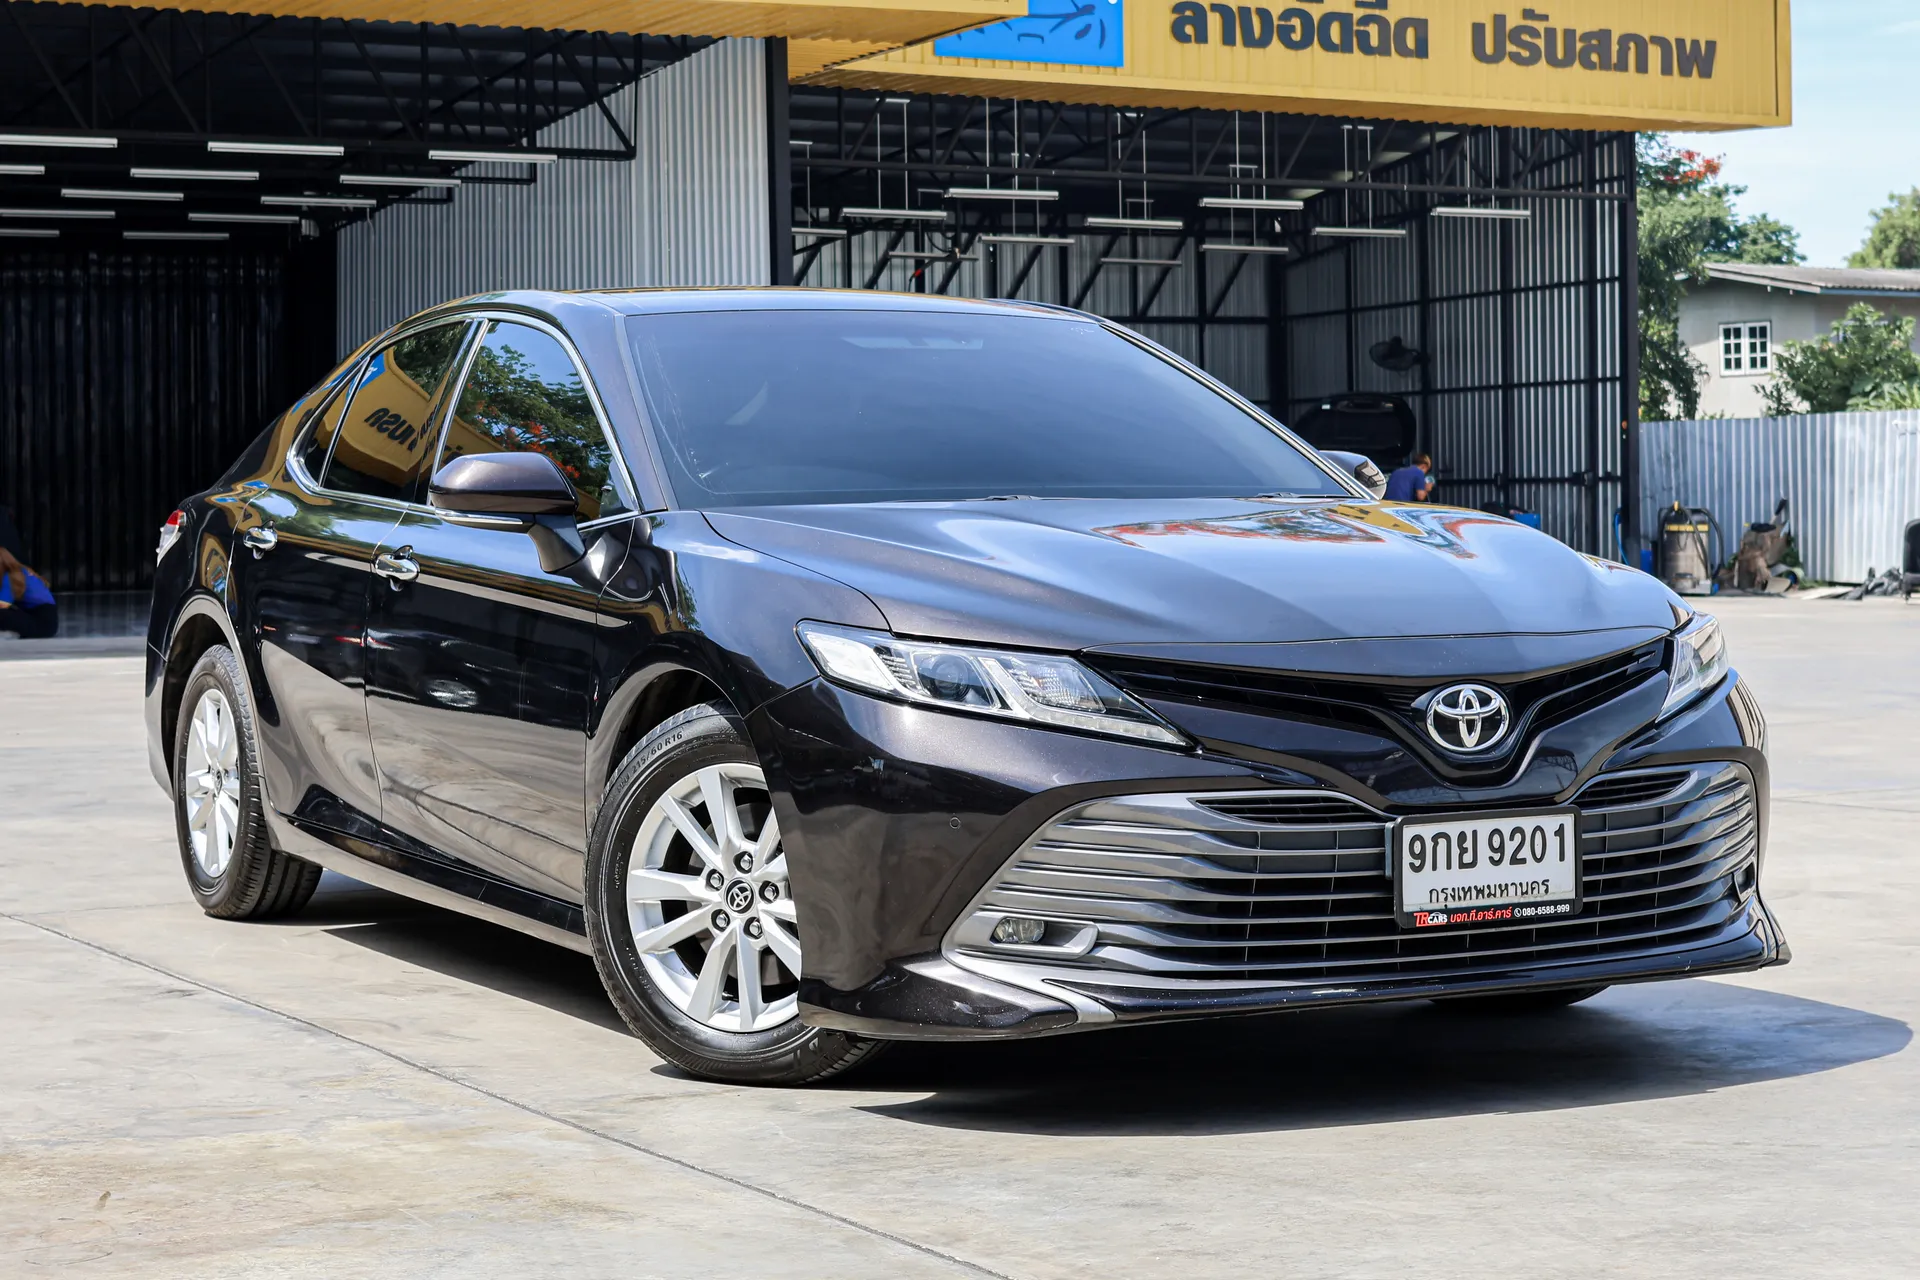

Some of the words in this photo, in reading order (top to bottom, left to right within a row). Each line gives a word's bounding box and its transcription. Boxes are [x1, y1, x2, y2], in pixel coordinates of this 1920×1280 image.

[1472, 8, 1717, 79] ปรับสภาพ
[631, 742, 663, 774] 215/60
[664, 730, 682, 747] R16
[1408, 829, 1478, 874] 9กย
[1487, 823, 1566, 867] 9201
[1428, 878, 1550, 909] กรุงเทพมหานคร
